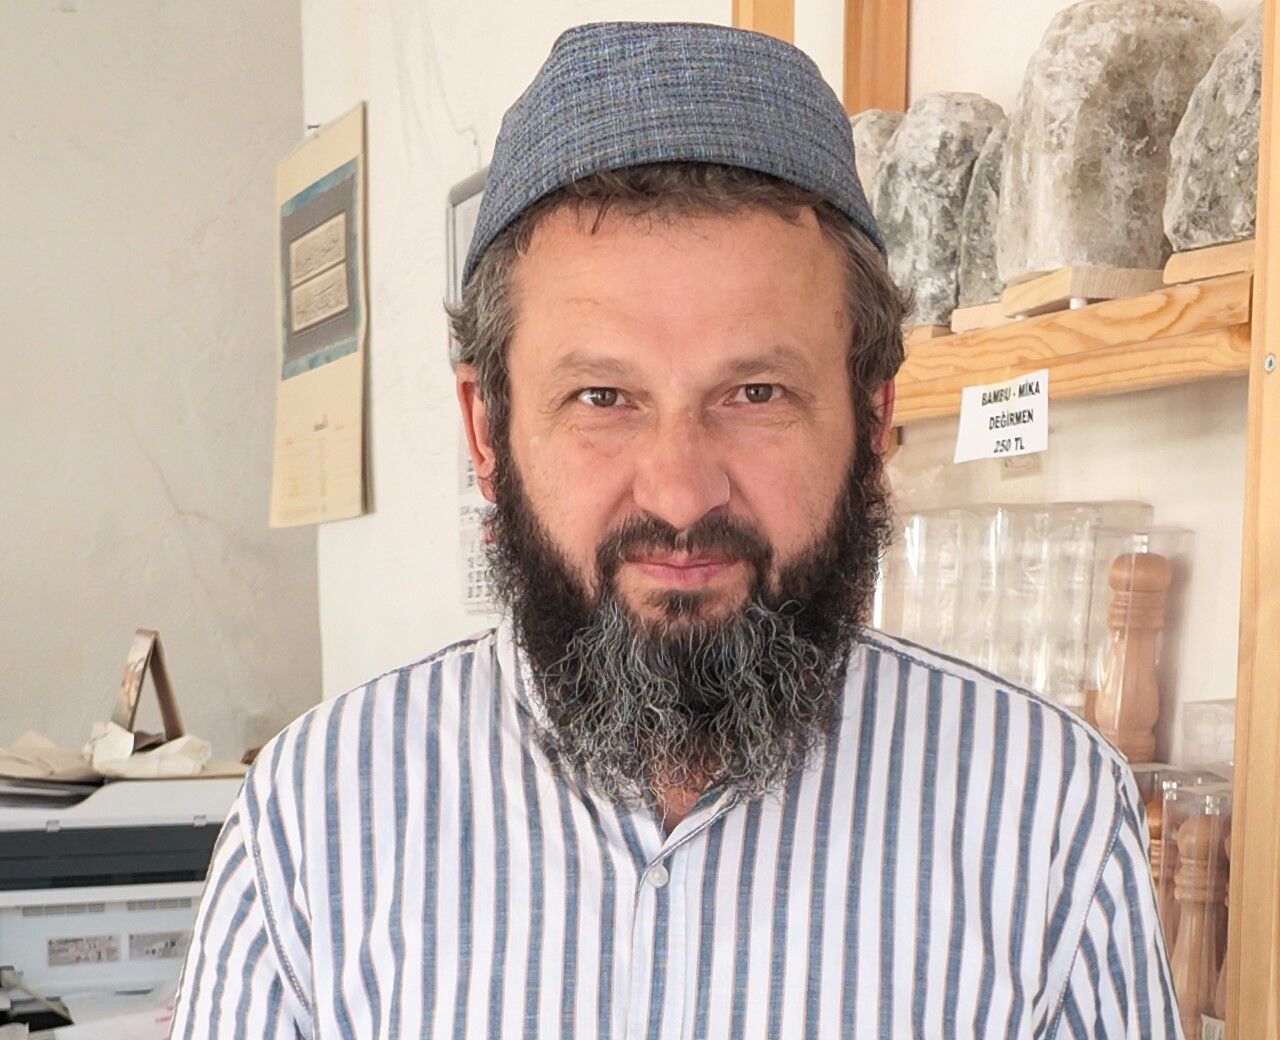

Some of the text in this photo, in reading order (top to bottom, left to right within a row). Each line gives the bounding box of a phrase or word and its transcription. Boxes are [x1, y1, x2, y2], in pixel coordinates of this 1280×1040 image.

[982, 386, 1011, 407] BAMBU
[1018, 380, 1040, 398] MİKA
[989, 408, 1034, 431] DEĞİRMEN
[993, 437, 1024, 453] 250 TL
